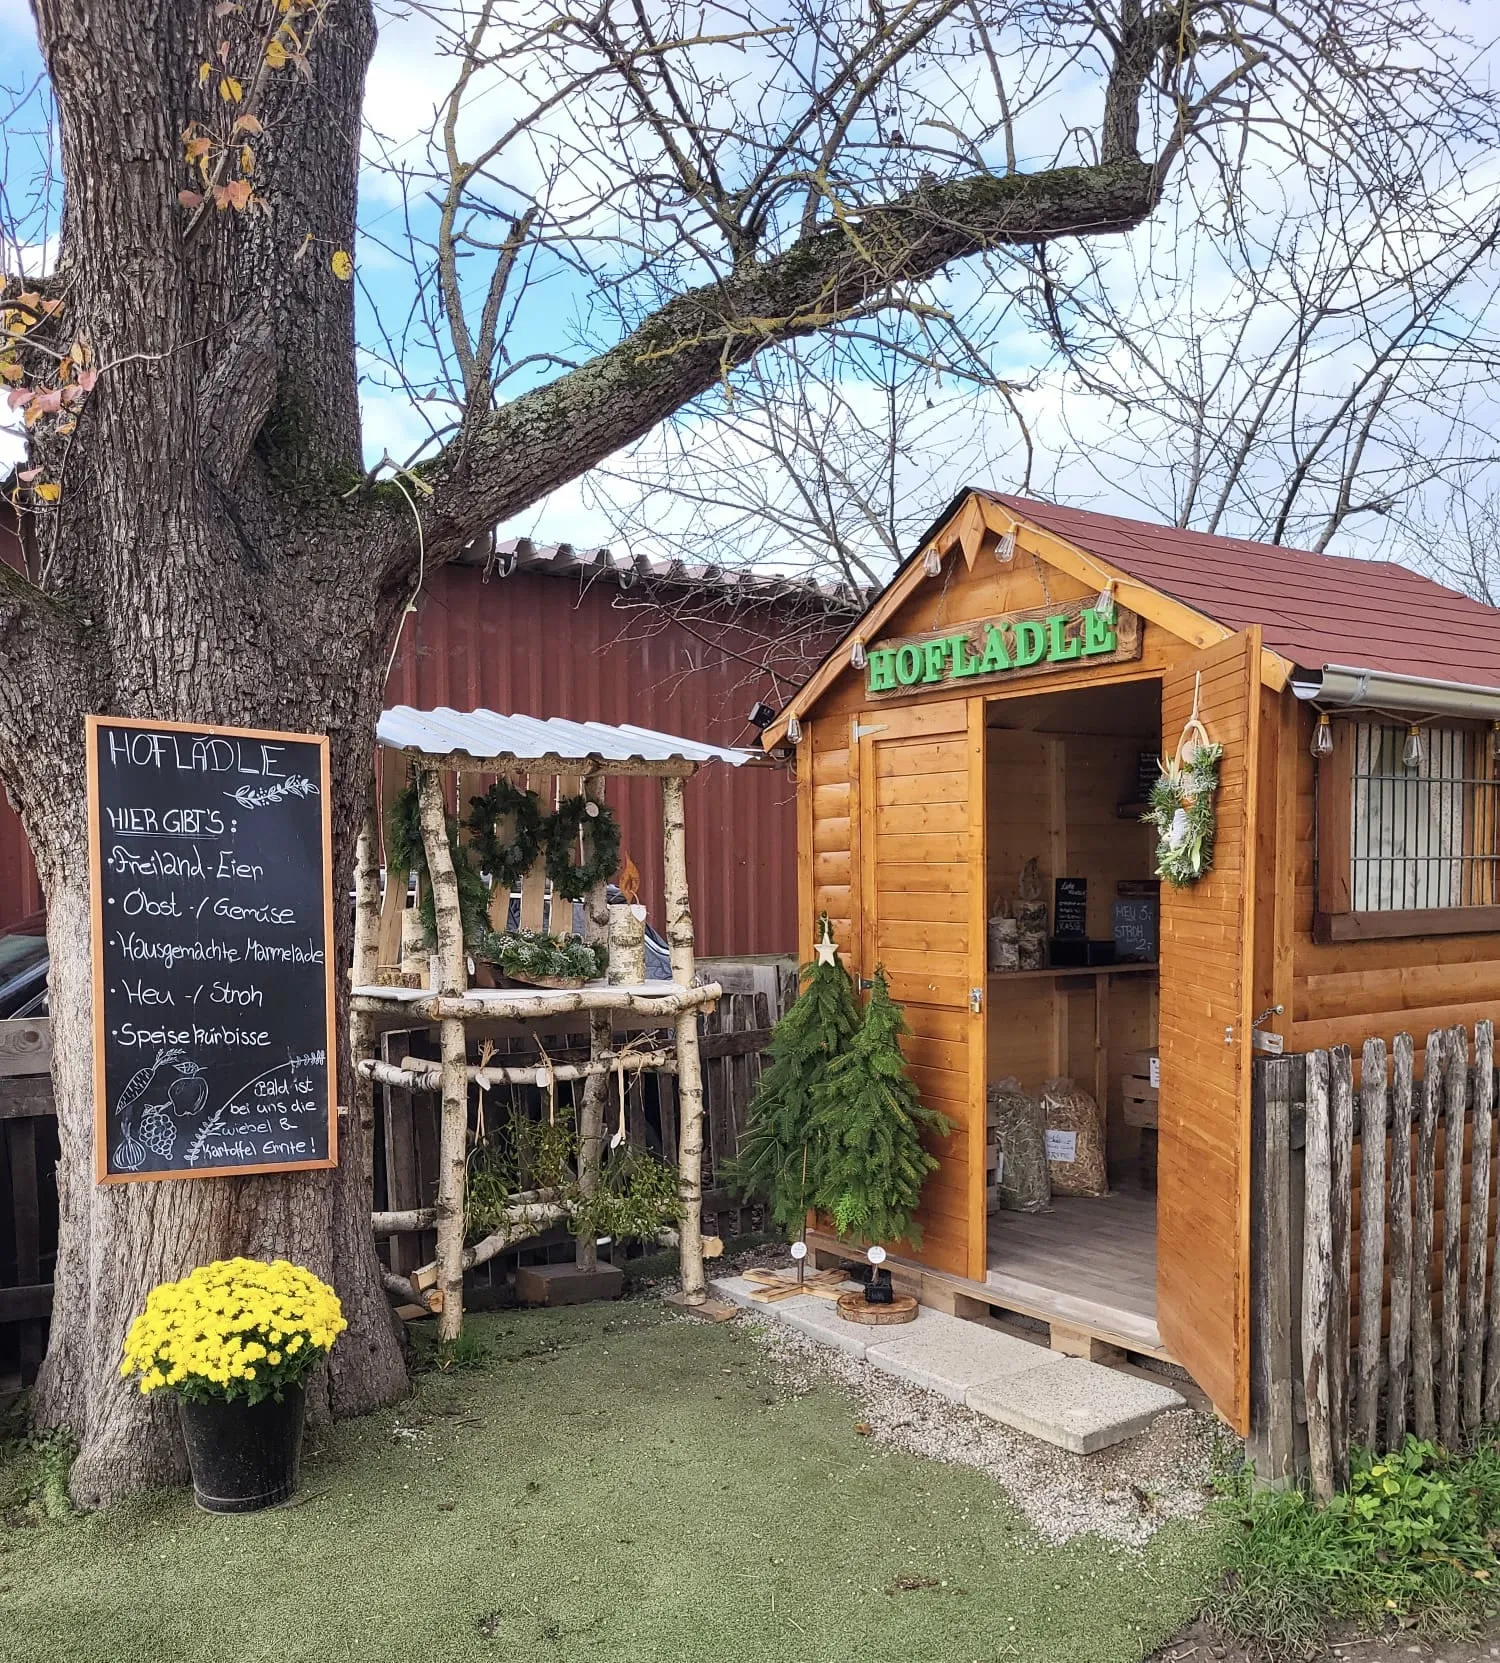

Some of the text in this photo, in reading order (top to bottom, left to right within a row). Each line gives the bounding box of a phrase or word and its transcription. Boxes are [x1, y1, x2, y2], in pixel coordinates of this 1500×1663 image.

[867, 607, 1118, 692] HOFLÄDLE
[107, 808, 158, 831] HIER
[112, 845, 263, 880] Freiland-Eier
[123, 888, 182, 916] Obst
[116, 931, 324, 968] Hausgemachte Marmelade
[122, 979, 175, 1006] Heu
[210, 981, 263, 1007] Stroh
[254, 1078, 314, 1097] Bald ist
[230, 1099, 317, 1115] bei uns die
[207, 1122, 273, 1137] Zwiebel
[202, 1141, 257, 1159] Kartoffel
